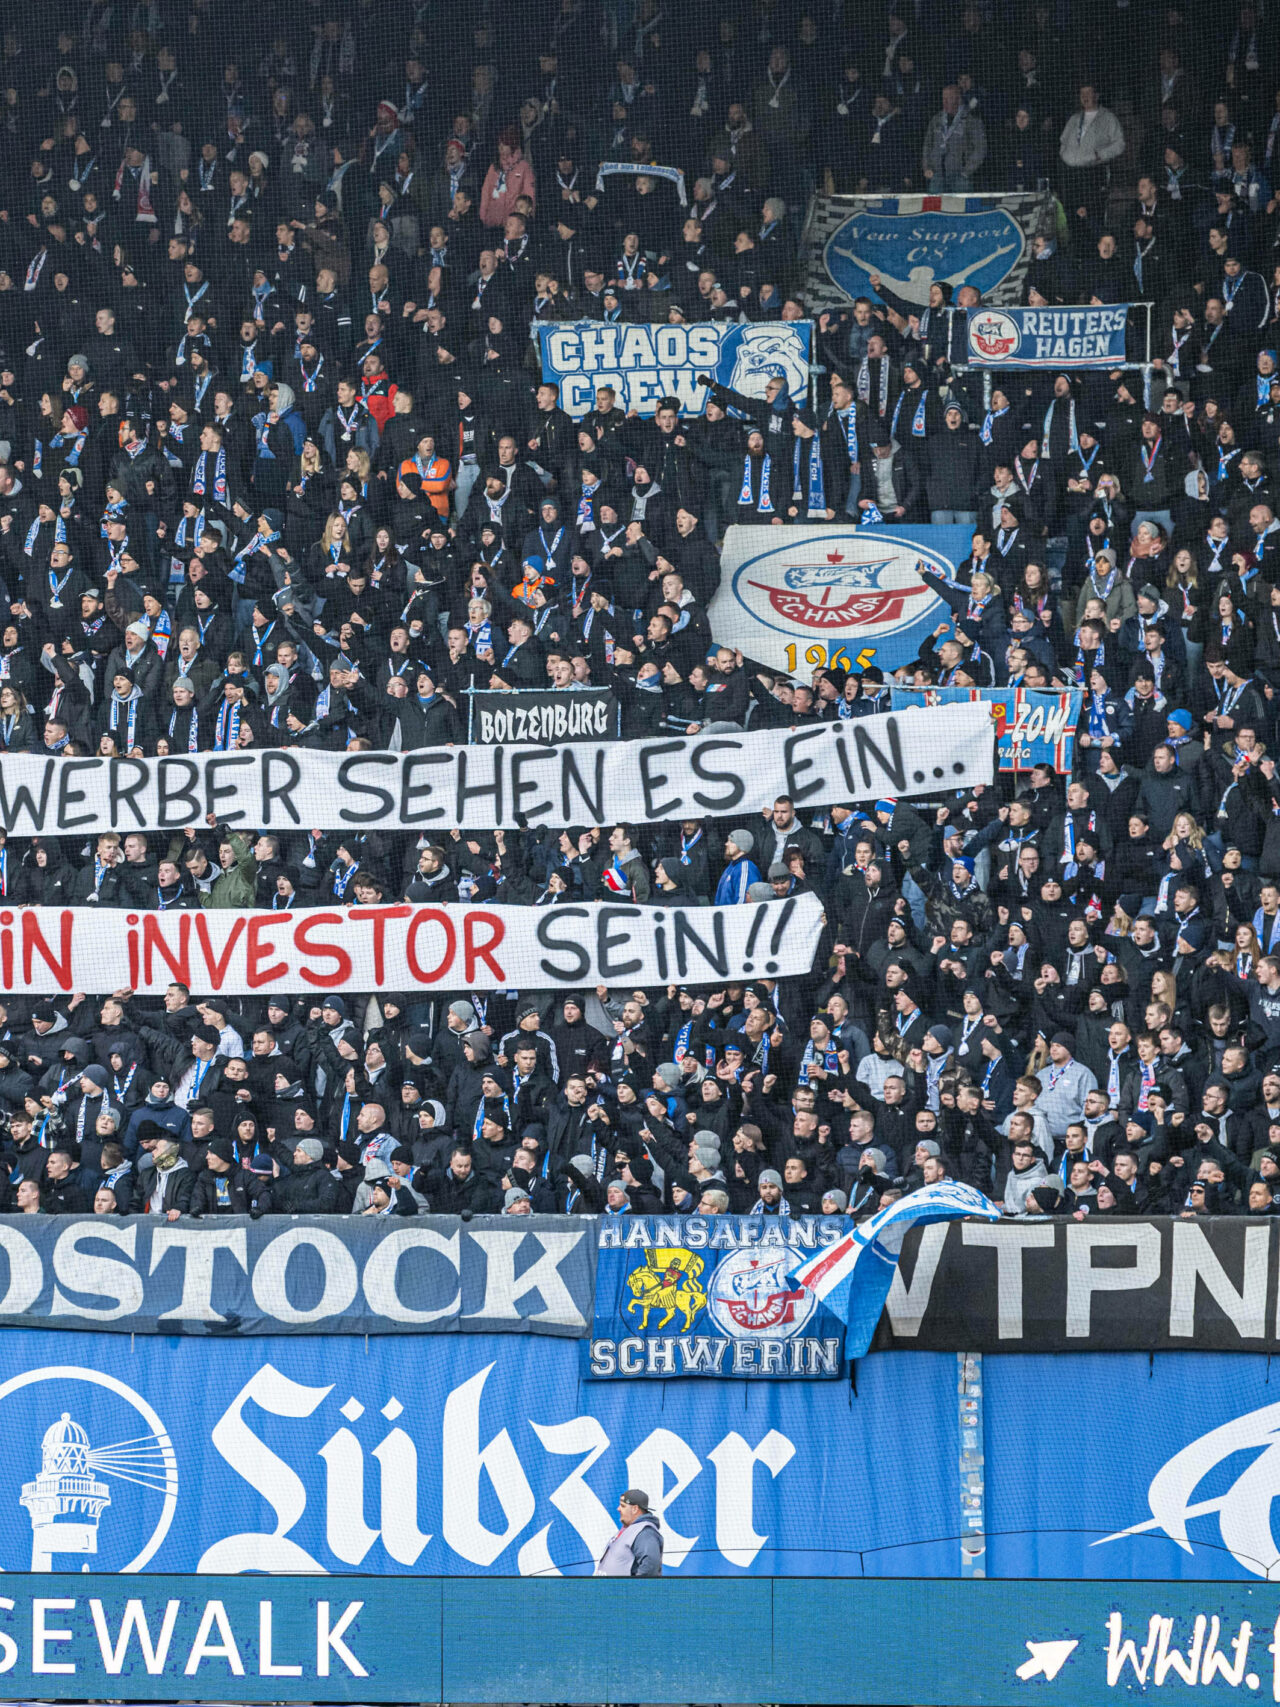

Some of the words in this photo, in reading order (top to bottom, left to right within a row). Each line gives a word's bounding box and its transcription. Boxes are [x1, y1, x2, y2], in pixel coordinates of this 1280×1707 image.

[843, 226, 900, 241] New
[907, 223, 1011, 244] Support
[1022, 309, 1126, 336] REUTERS
[548, 325, 721, 373] CHAOS
[1036, 334, 1110, 358] HAGEN
[560, 370, 711, 418] CREW
[804, 596, 885, 623] HANSA
[784, 643, 877, 675] 1965
[480, 699, 609, 744] BOIZENBURG
[336, 743, 606, 826] SEHEN
[637, 739, 747, 819] ES
[598, 1216, 844, 1250] HANSAFANS
[589, 1336, 839, 1377] SCHWERIN
[196, 1360, 797, 1576] Lübzer
